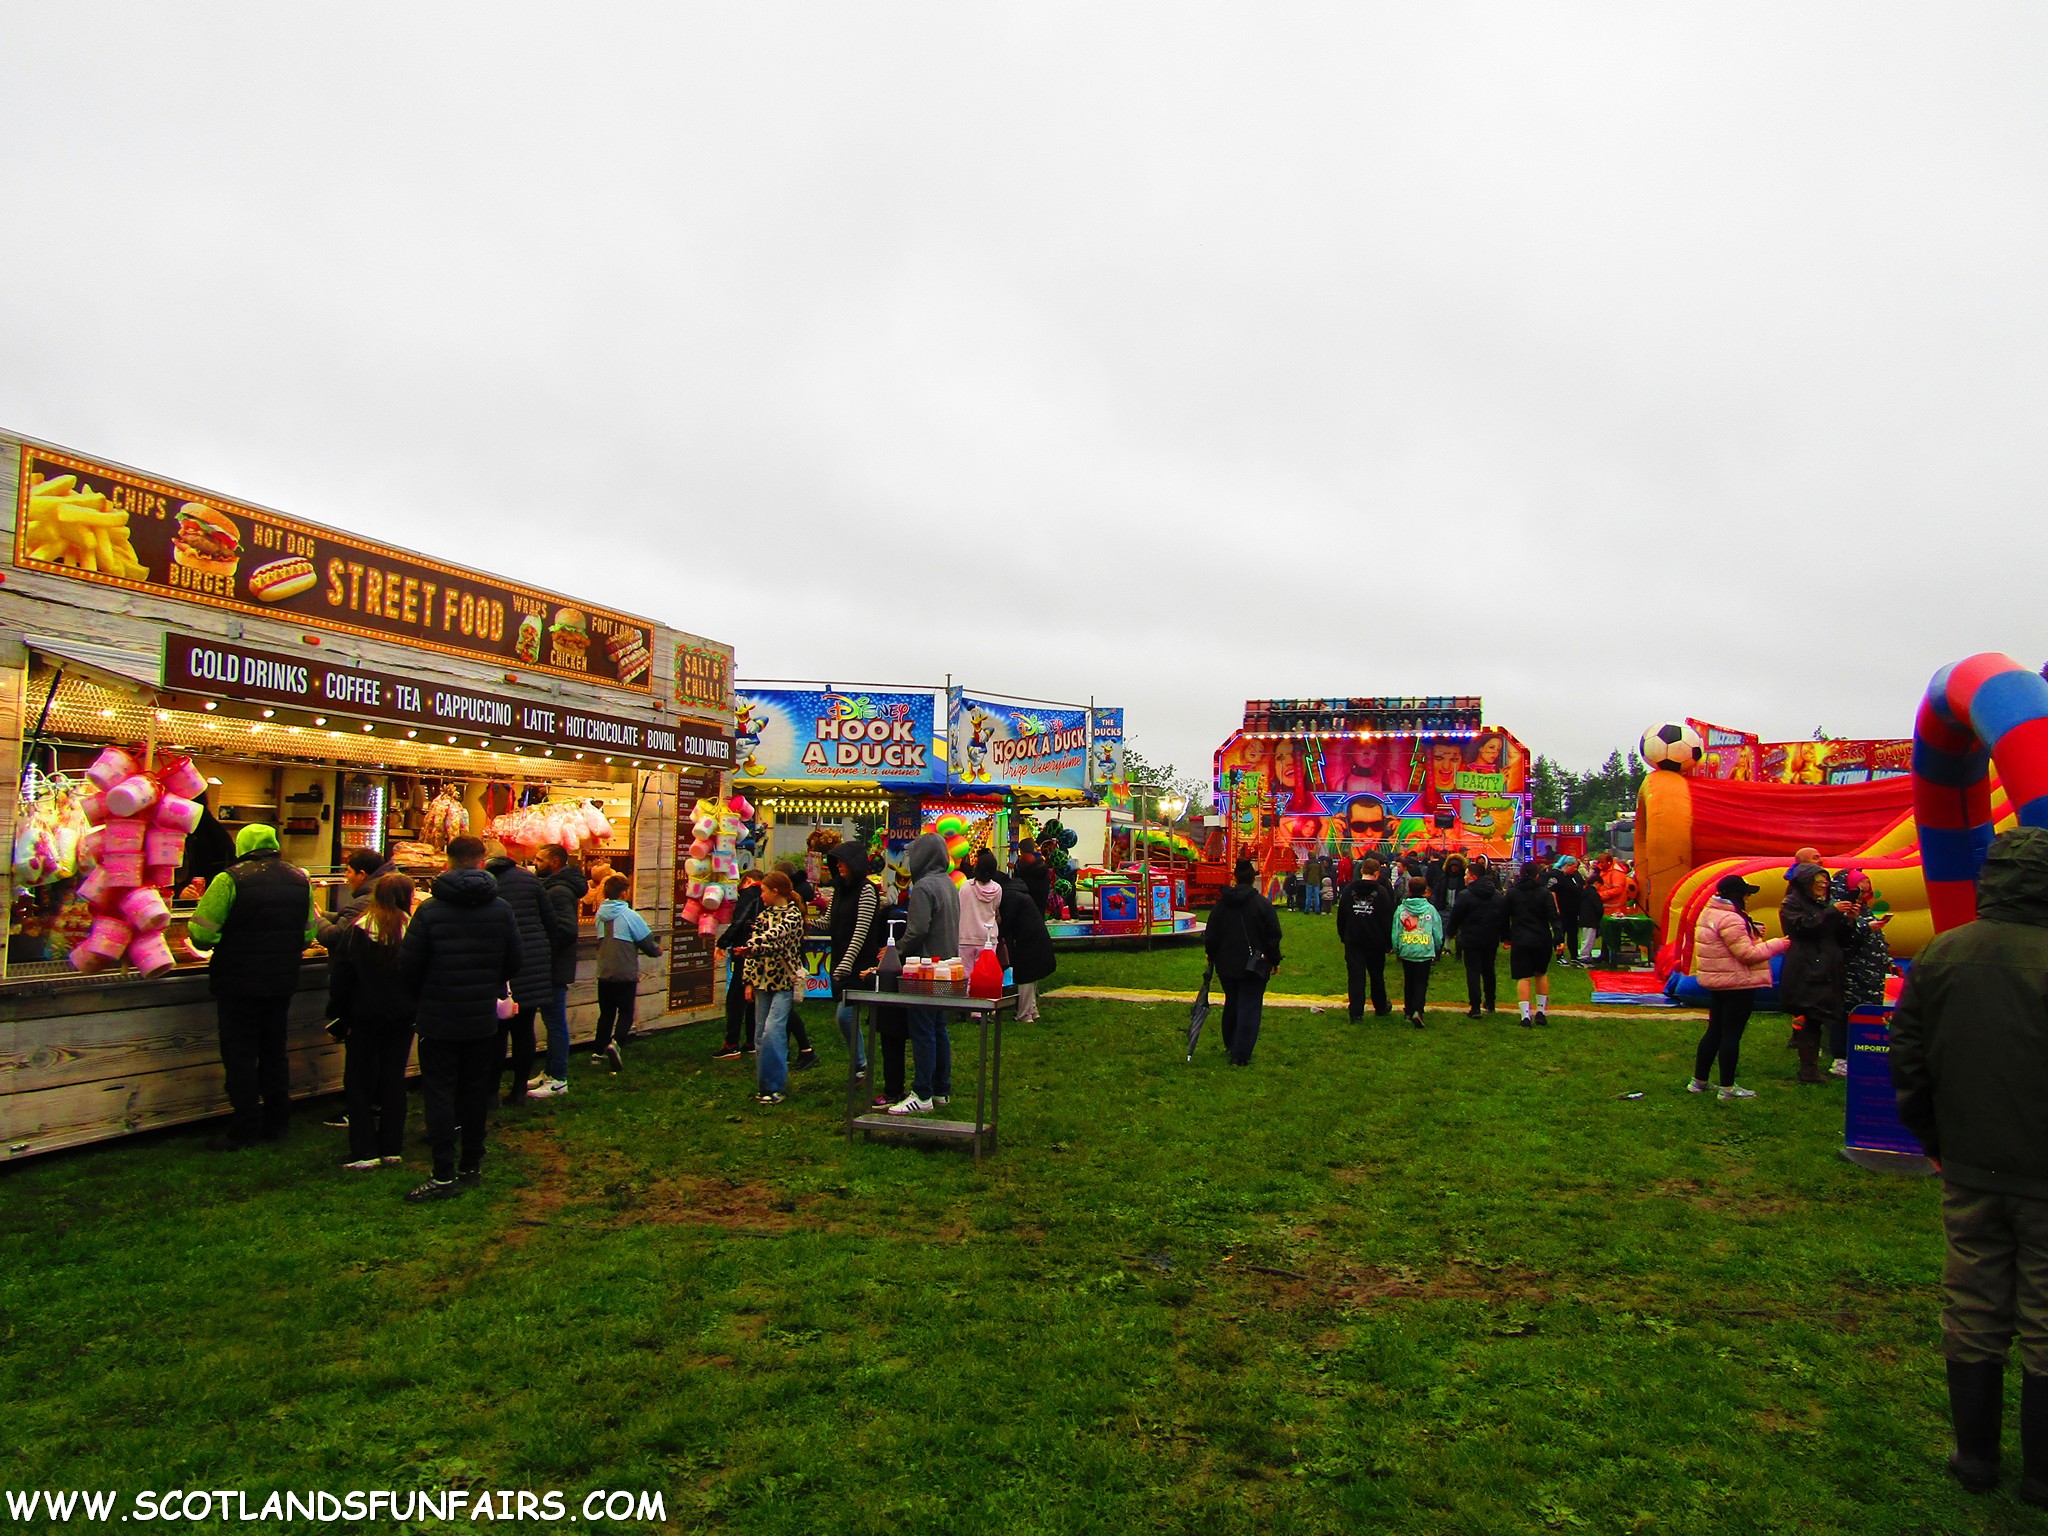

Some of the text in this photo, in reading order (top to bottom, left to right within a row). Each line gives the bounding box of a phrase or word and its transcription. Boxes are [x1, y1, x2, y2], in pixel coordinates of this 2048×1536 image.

[112, 485, 167, 520] CHIPS
[253, 523, 316, 559] HOT DOG
[168, 562, 236, 599] BURGER
[325, 557, 505, 643] STREET FOOD
[512, 595, 548, 619] WRAPS
[591, 616, 613, 635] FOOT
[550, 650, 588, 672] CHICKEN
[684, 654, 710, 678] SALT
[685, 677, 720, 702] CHILLI
[190, 647, 730, 760] COLD DRINKS COFFEE TEA CAPPUCCINO LATTE HOT CHOCOLATE BOVRIL COLD WATER
[816, 718, 916, 742] HOOK
[1094, 727, 1122, 736] DUCKS
[1101, 719, 1115, 727] THE
[801, 741, 927, 767] A DUCK
[993, 726, 1086, 764] HOOK A DUCK
[1874, 743, 1913, 762] DANC
[881, 767, 921, 776] winner
[1002, 758, 1028, 783] Prize
[1462, 773, 1500, 790] PARTY
[897, 817, 912, 826] THE
[889, 830, 921, 840] DUCKS
[1854, 1044, 1890, 1053] IMPORTA
